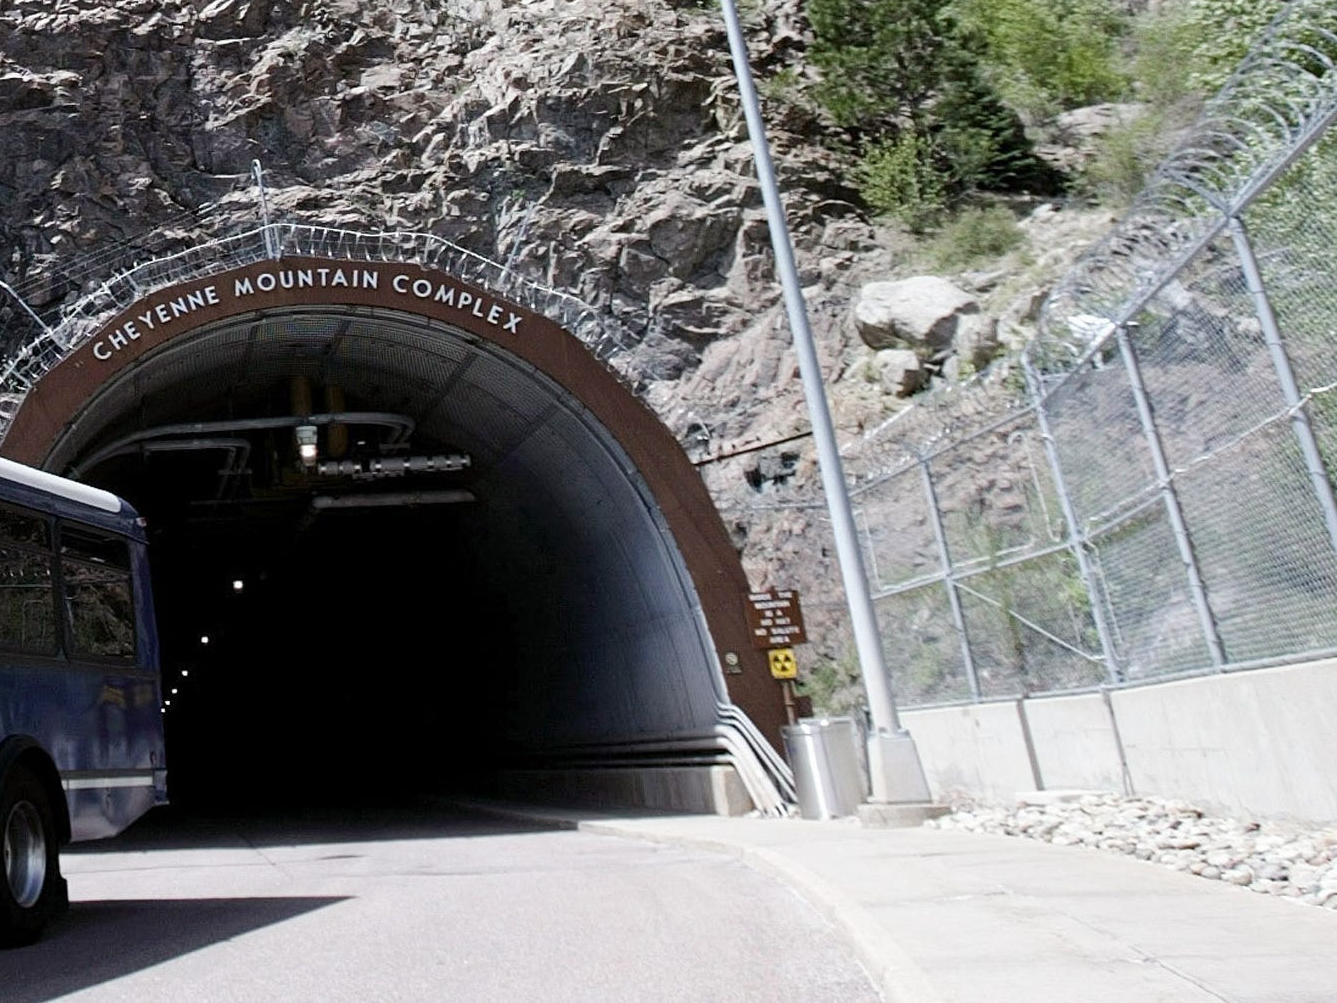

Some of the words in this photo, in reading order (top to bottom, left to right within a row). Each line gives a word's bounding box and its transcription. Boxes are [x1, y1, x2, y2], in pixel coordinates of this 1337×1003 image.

[93, 285, 220, 361] CHEYENNE
[234, 268, 379, 296] MOUNTAIN
[393, 274, 524, 334] COMPLEX
